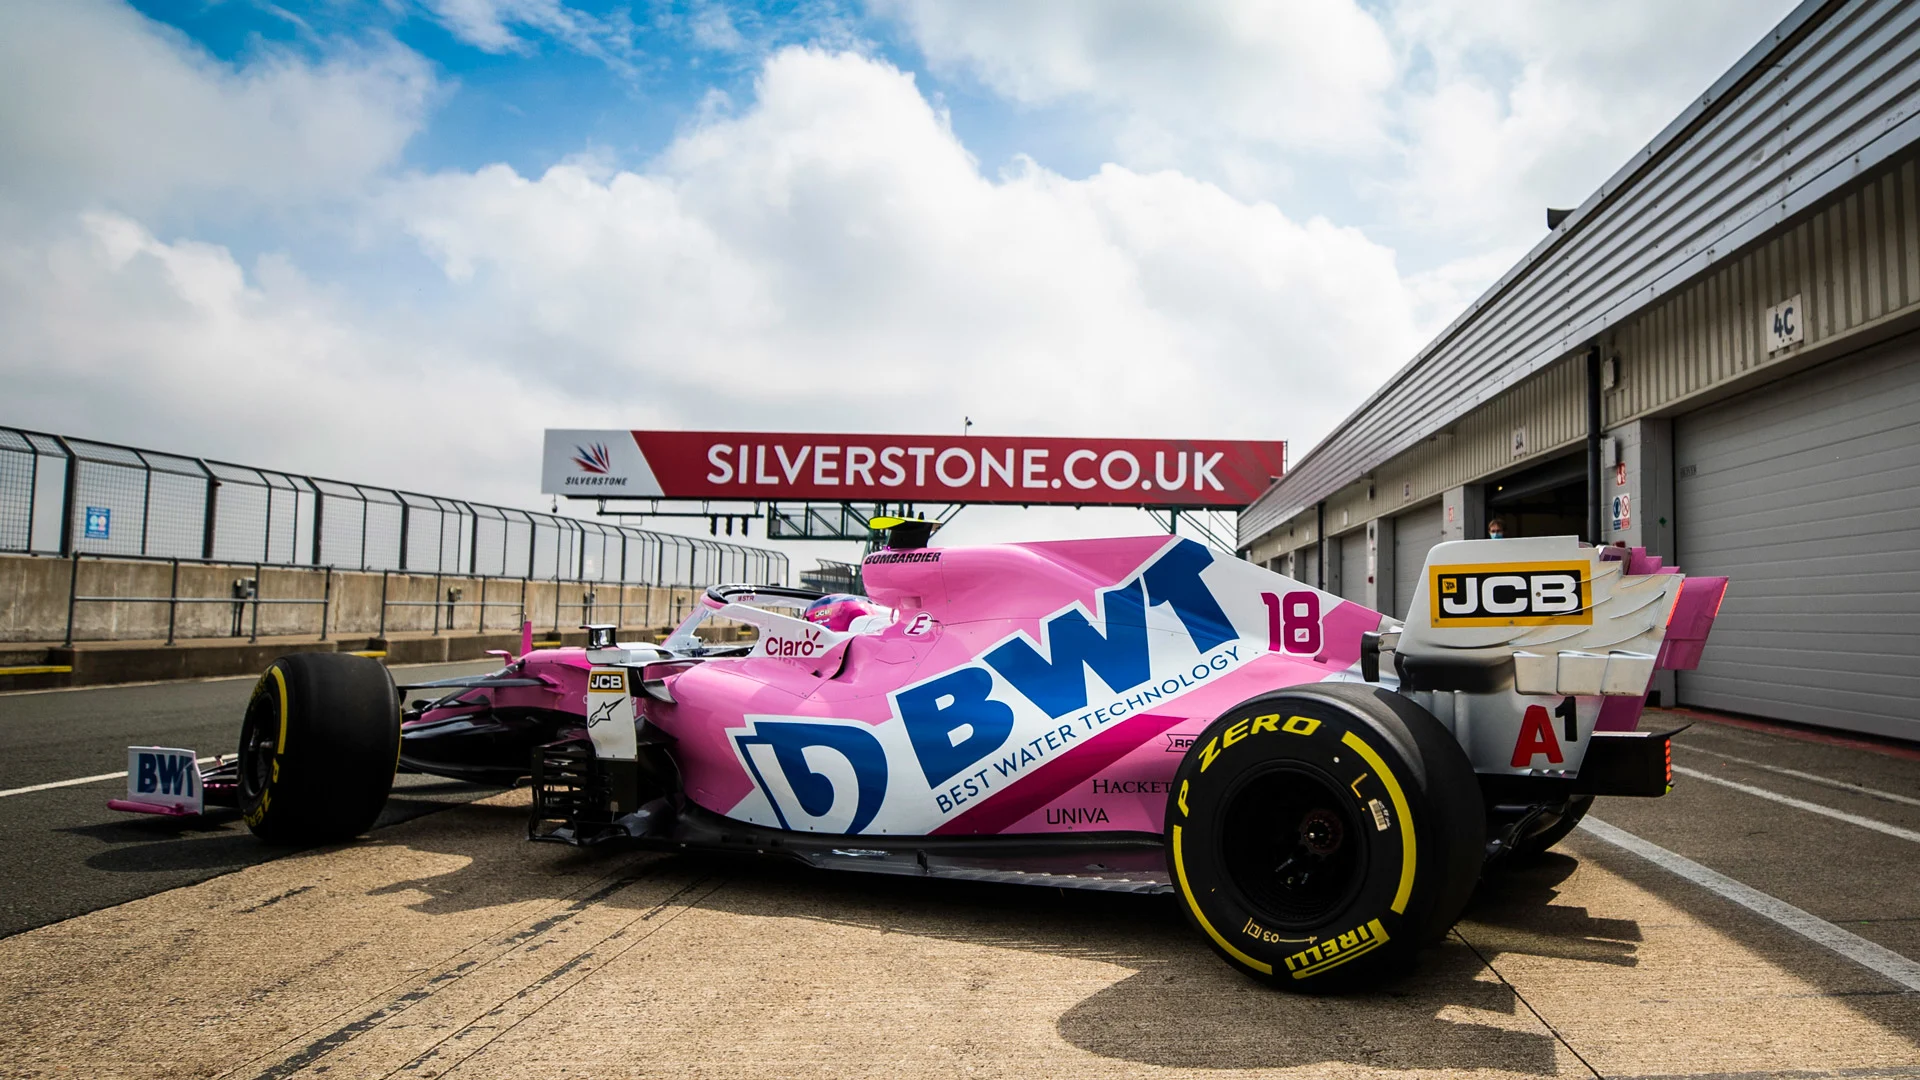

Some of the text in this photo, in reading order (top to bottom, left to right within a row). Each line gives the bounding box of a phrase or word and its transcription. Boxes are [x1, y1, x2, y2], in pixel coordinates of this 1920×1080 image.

[1774, 307, 1794, 338] 4C
[565, 476, 628, 486] SILVERSTONE
[707, 444, 1225, 491] SILVERSTONE.CO.UK
[864, 552, 941, 565] BOMBARDIER
[1443, 575, 1578, 614] JCB
[1260, 591, 1321, 654] 18
[765, 636, 816, 656] Claro
[895, 537, 1240, 790] BWT
[591, 675, 622, 689] JCB
[935, 645, 1241, 815] BEST WATER TECHNOLOGY
[1510, 695, 1578, 768] A1
[137, 753, 194, 797] BWT
[1092, 779, 1172, 794] HACKET
[1178, 714, 1322, 818] P ZERO
[1047, 808, 1110, 824] UNIVA
[1284, 918, 1390, 980] PIRELLI
